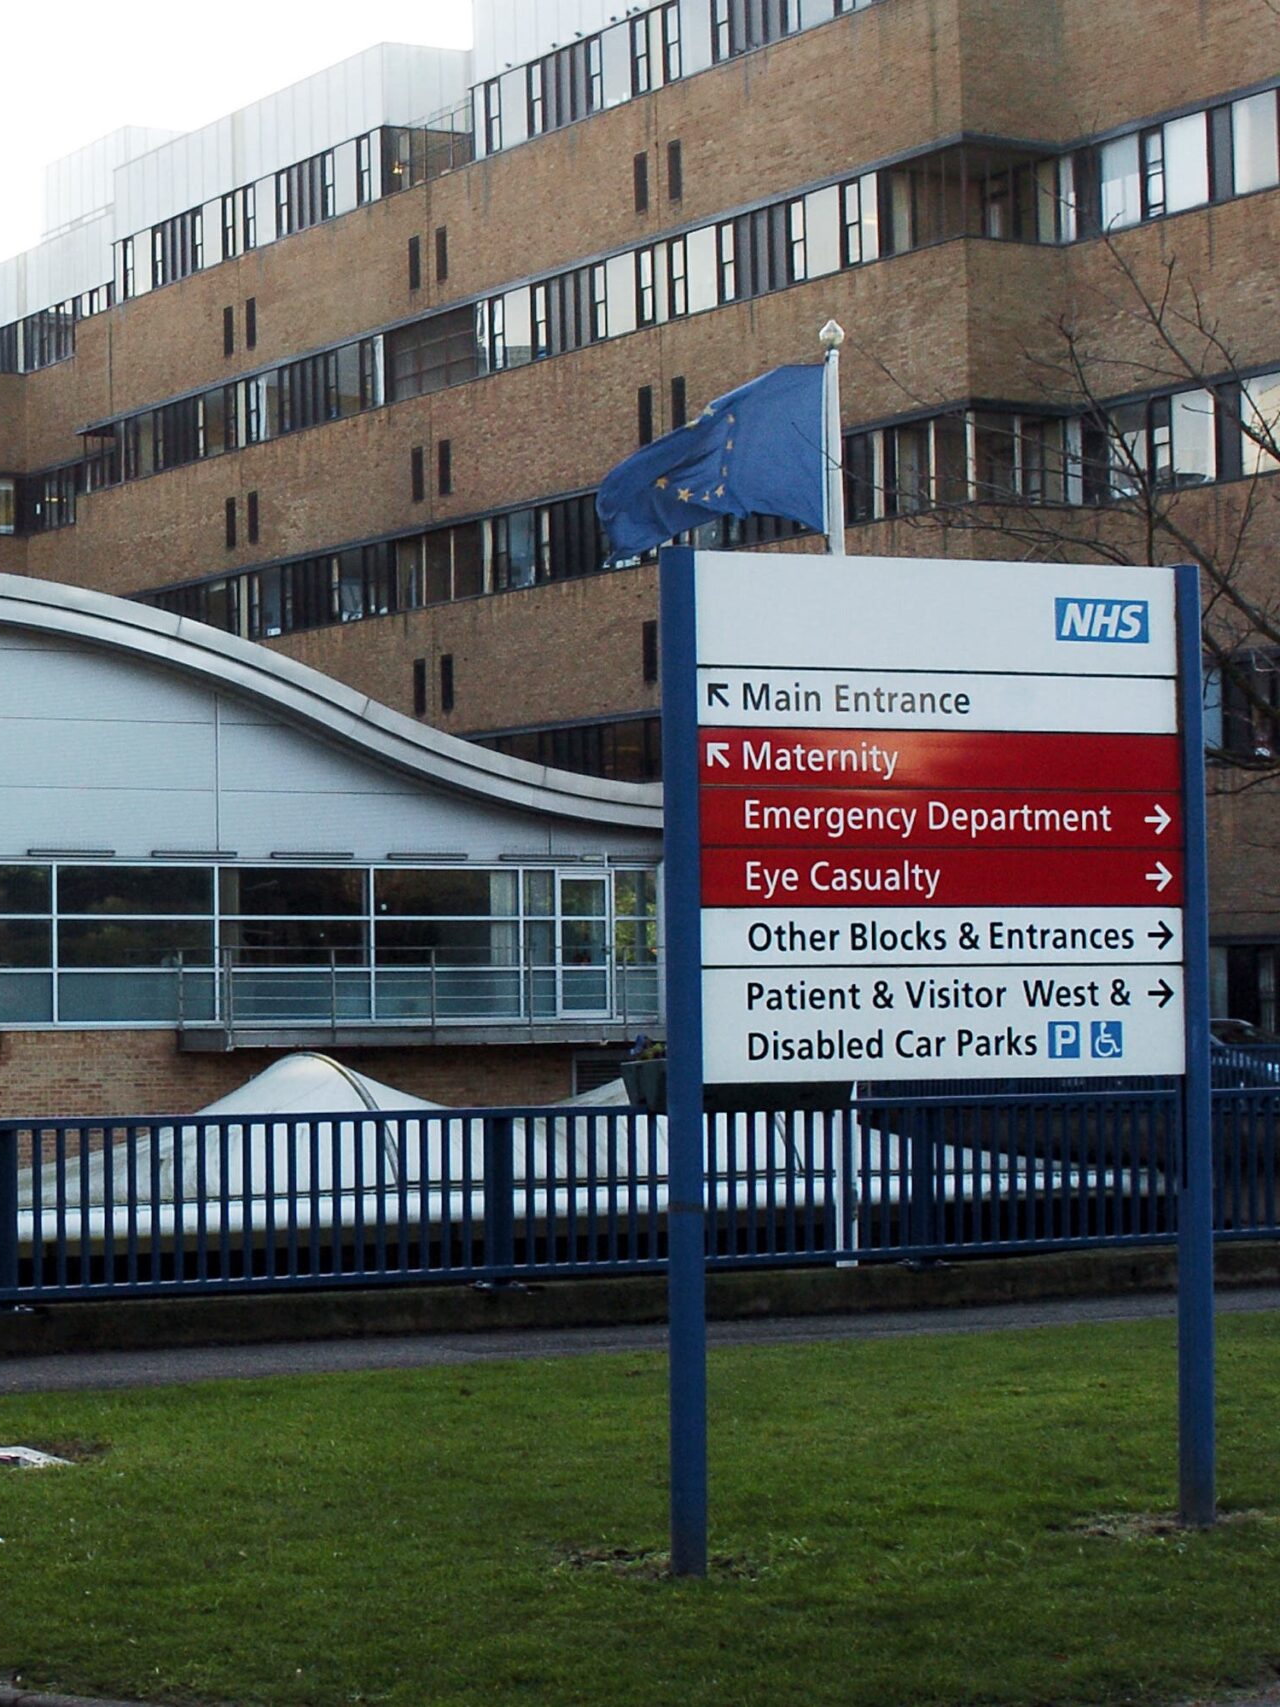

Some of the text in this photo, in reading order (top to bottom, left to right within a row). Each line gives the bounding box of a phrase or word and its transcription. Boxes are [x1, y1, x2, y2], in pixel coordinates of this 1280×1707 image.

[1061, 603, 1143, 639] NHS
[742, 682, 970, 714] Main Entrance
[743, 740, 898, 780] Maternity
[744, 799, 1112, 838] Emergency Department
[746, 859, 941, 899] Eye Casualty
[748, 920, 1135, 951] Other Blocks & Entrances
[747, 978, 1131, 1010] Patient & Visitor West &
[748, 1026, 1038, 1061] Disabled Car Parks
[1054, 1024, 1076, 1056] P
